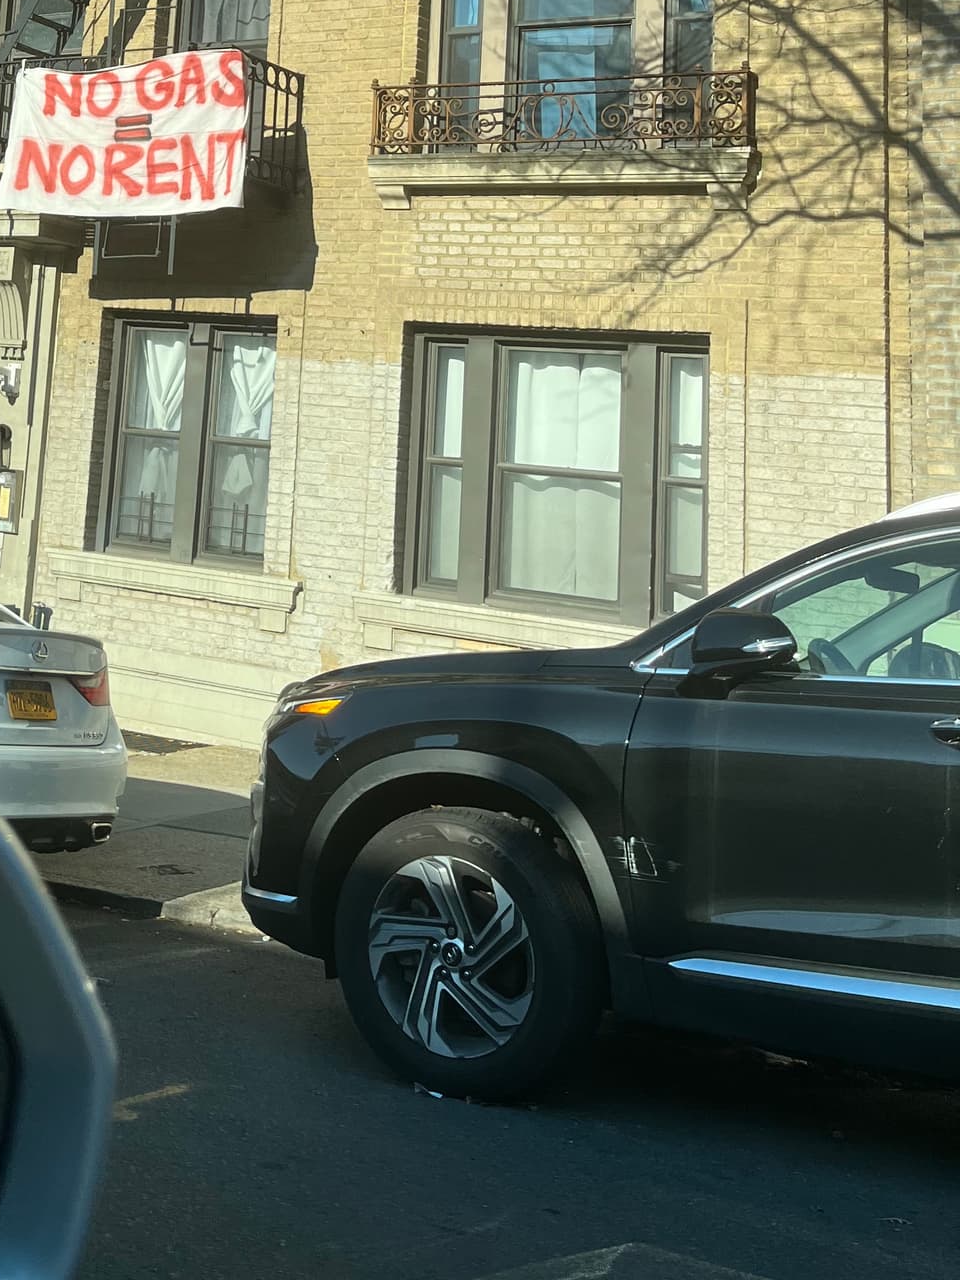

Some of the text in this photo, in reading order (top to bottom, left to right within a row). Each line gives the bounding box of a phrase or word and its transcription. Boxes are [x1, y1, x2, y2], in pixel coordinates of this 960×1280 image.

[43, 51, 246, 117] NO GAS
[14, 128, 246, 200] NO RENT
